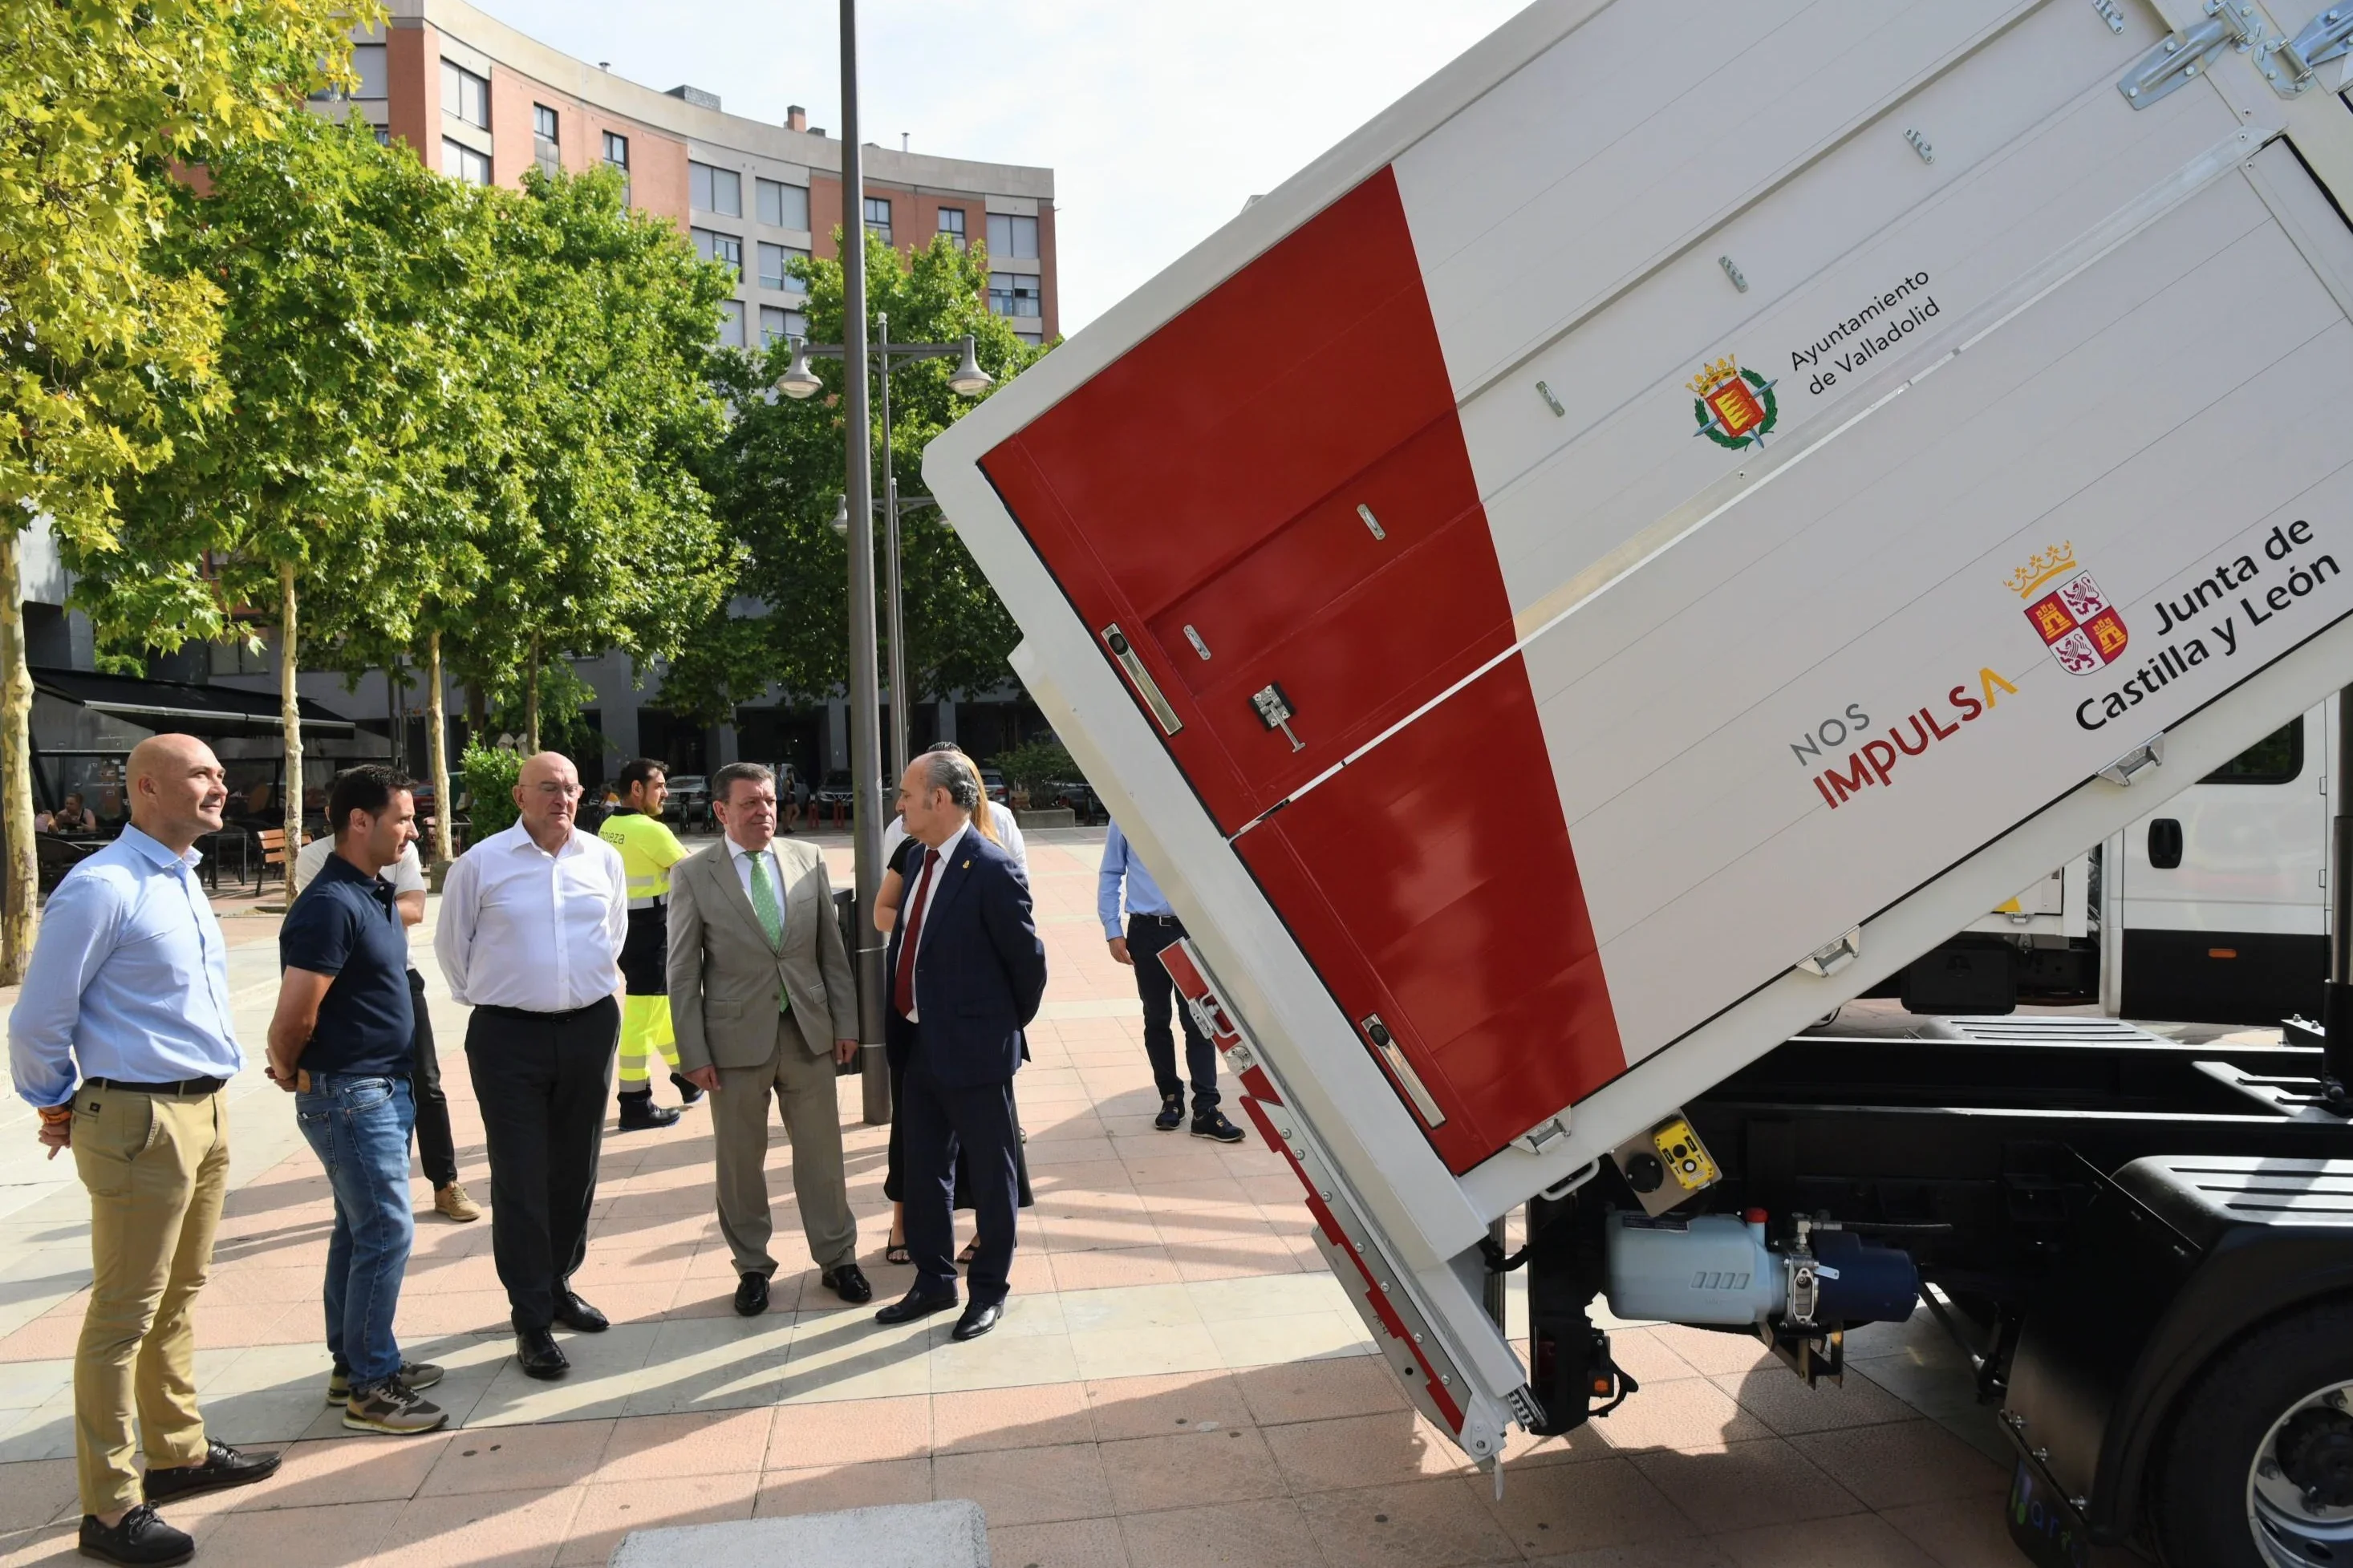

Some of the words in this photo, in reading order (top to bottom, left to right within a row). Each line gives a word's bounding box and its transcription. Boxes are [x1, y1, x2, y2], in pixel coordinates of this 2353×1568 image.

[1791, 270, 1929, 371] Ayuntamiento
[1809, 372, 1836, 395] de
[1834, 296, 1941, 373] Valladolid
[2154, 555, 2260, 636] Junta
[2264, 520, 2314, 561] de
[2075, 638, 2210, 731] Castilla
[2210, 616, 2237, 657] y
[2239, 554, 2341, 628] León
[1789, 703, 1870, 767] NOS
[1813, 667, 2018, 810] IMPULSA
